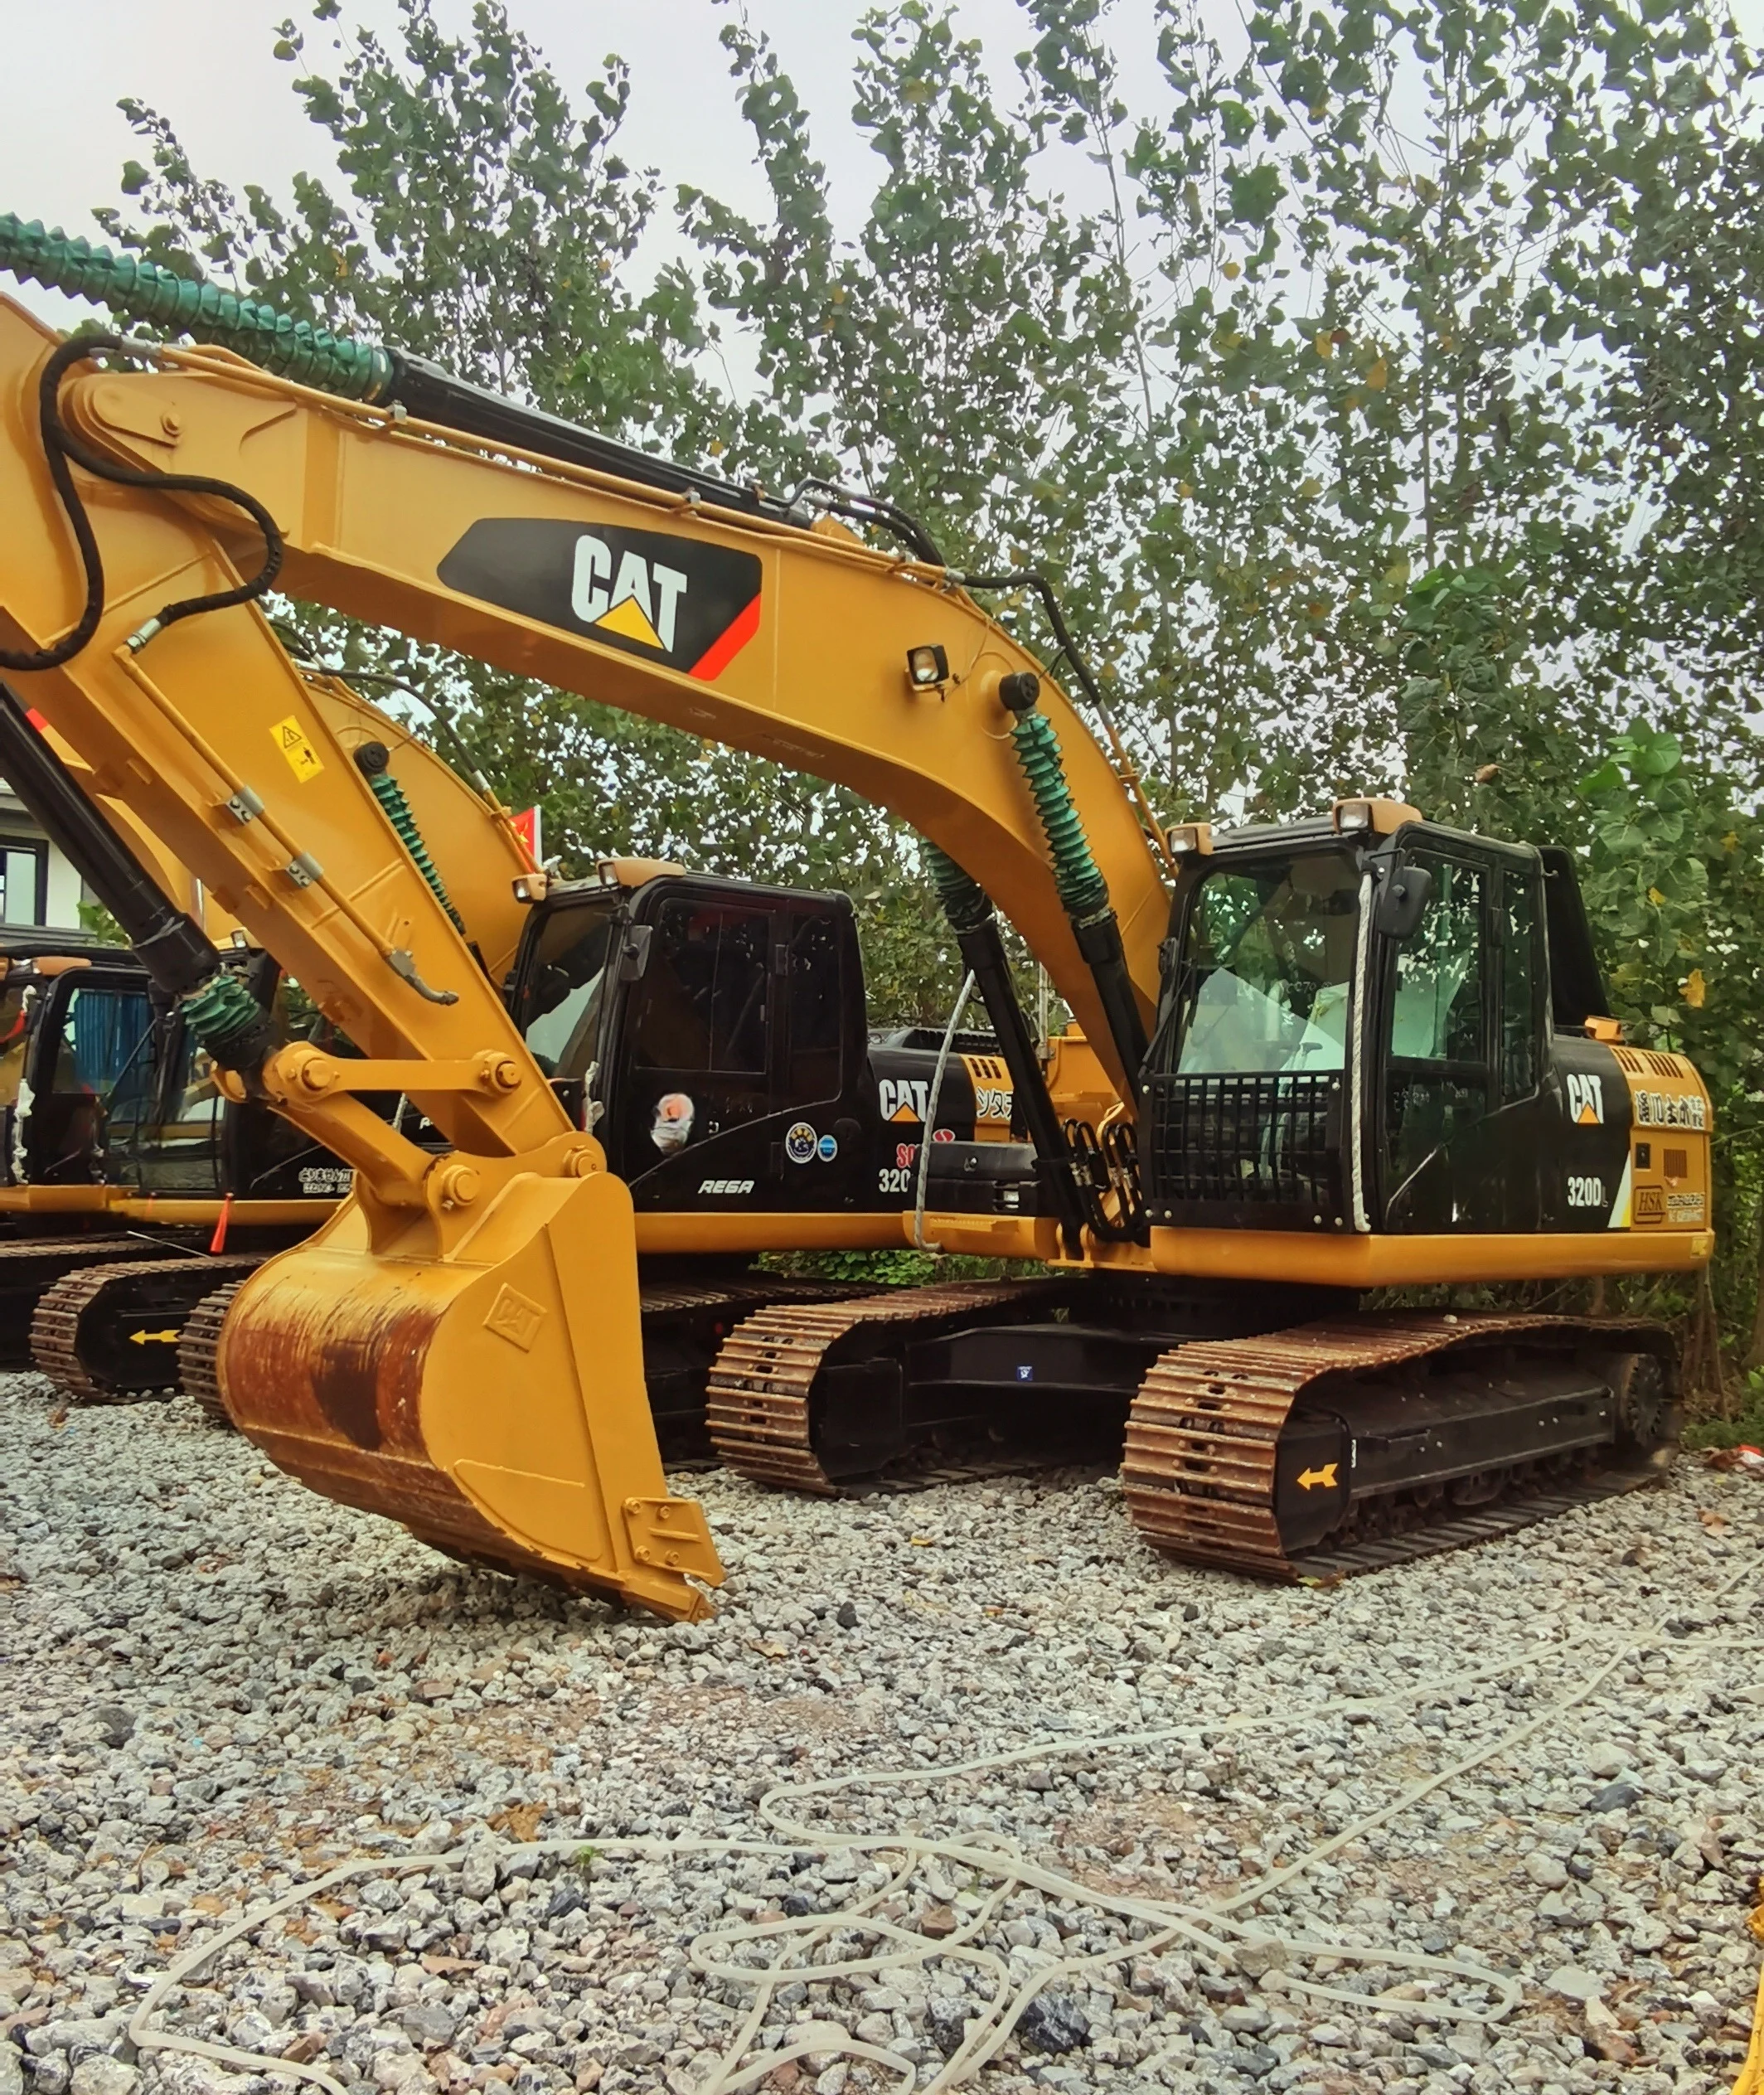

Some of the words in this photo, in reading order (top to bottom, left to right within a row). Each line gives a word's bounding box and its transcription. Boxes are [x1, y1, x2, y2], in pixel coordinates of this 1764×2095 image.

[572, 535, 687, 652] CAT
[880, 1079, 928, 1122] CAT
[1567, 1074, 1604, 1124] CAT
[698, 1180, 754, 1194] REGA
